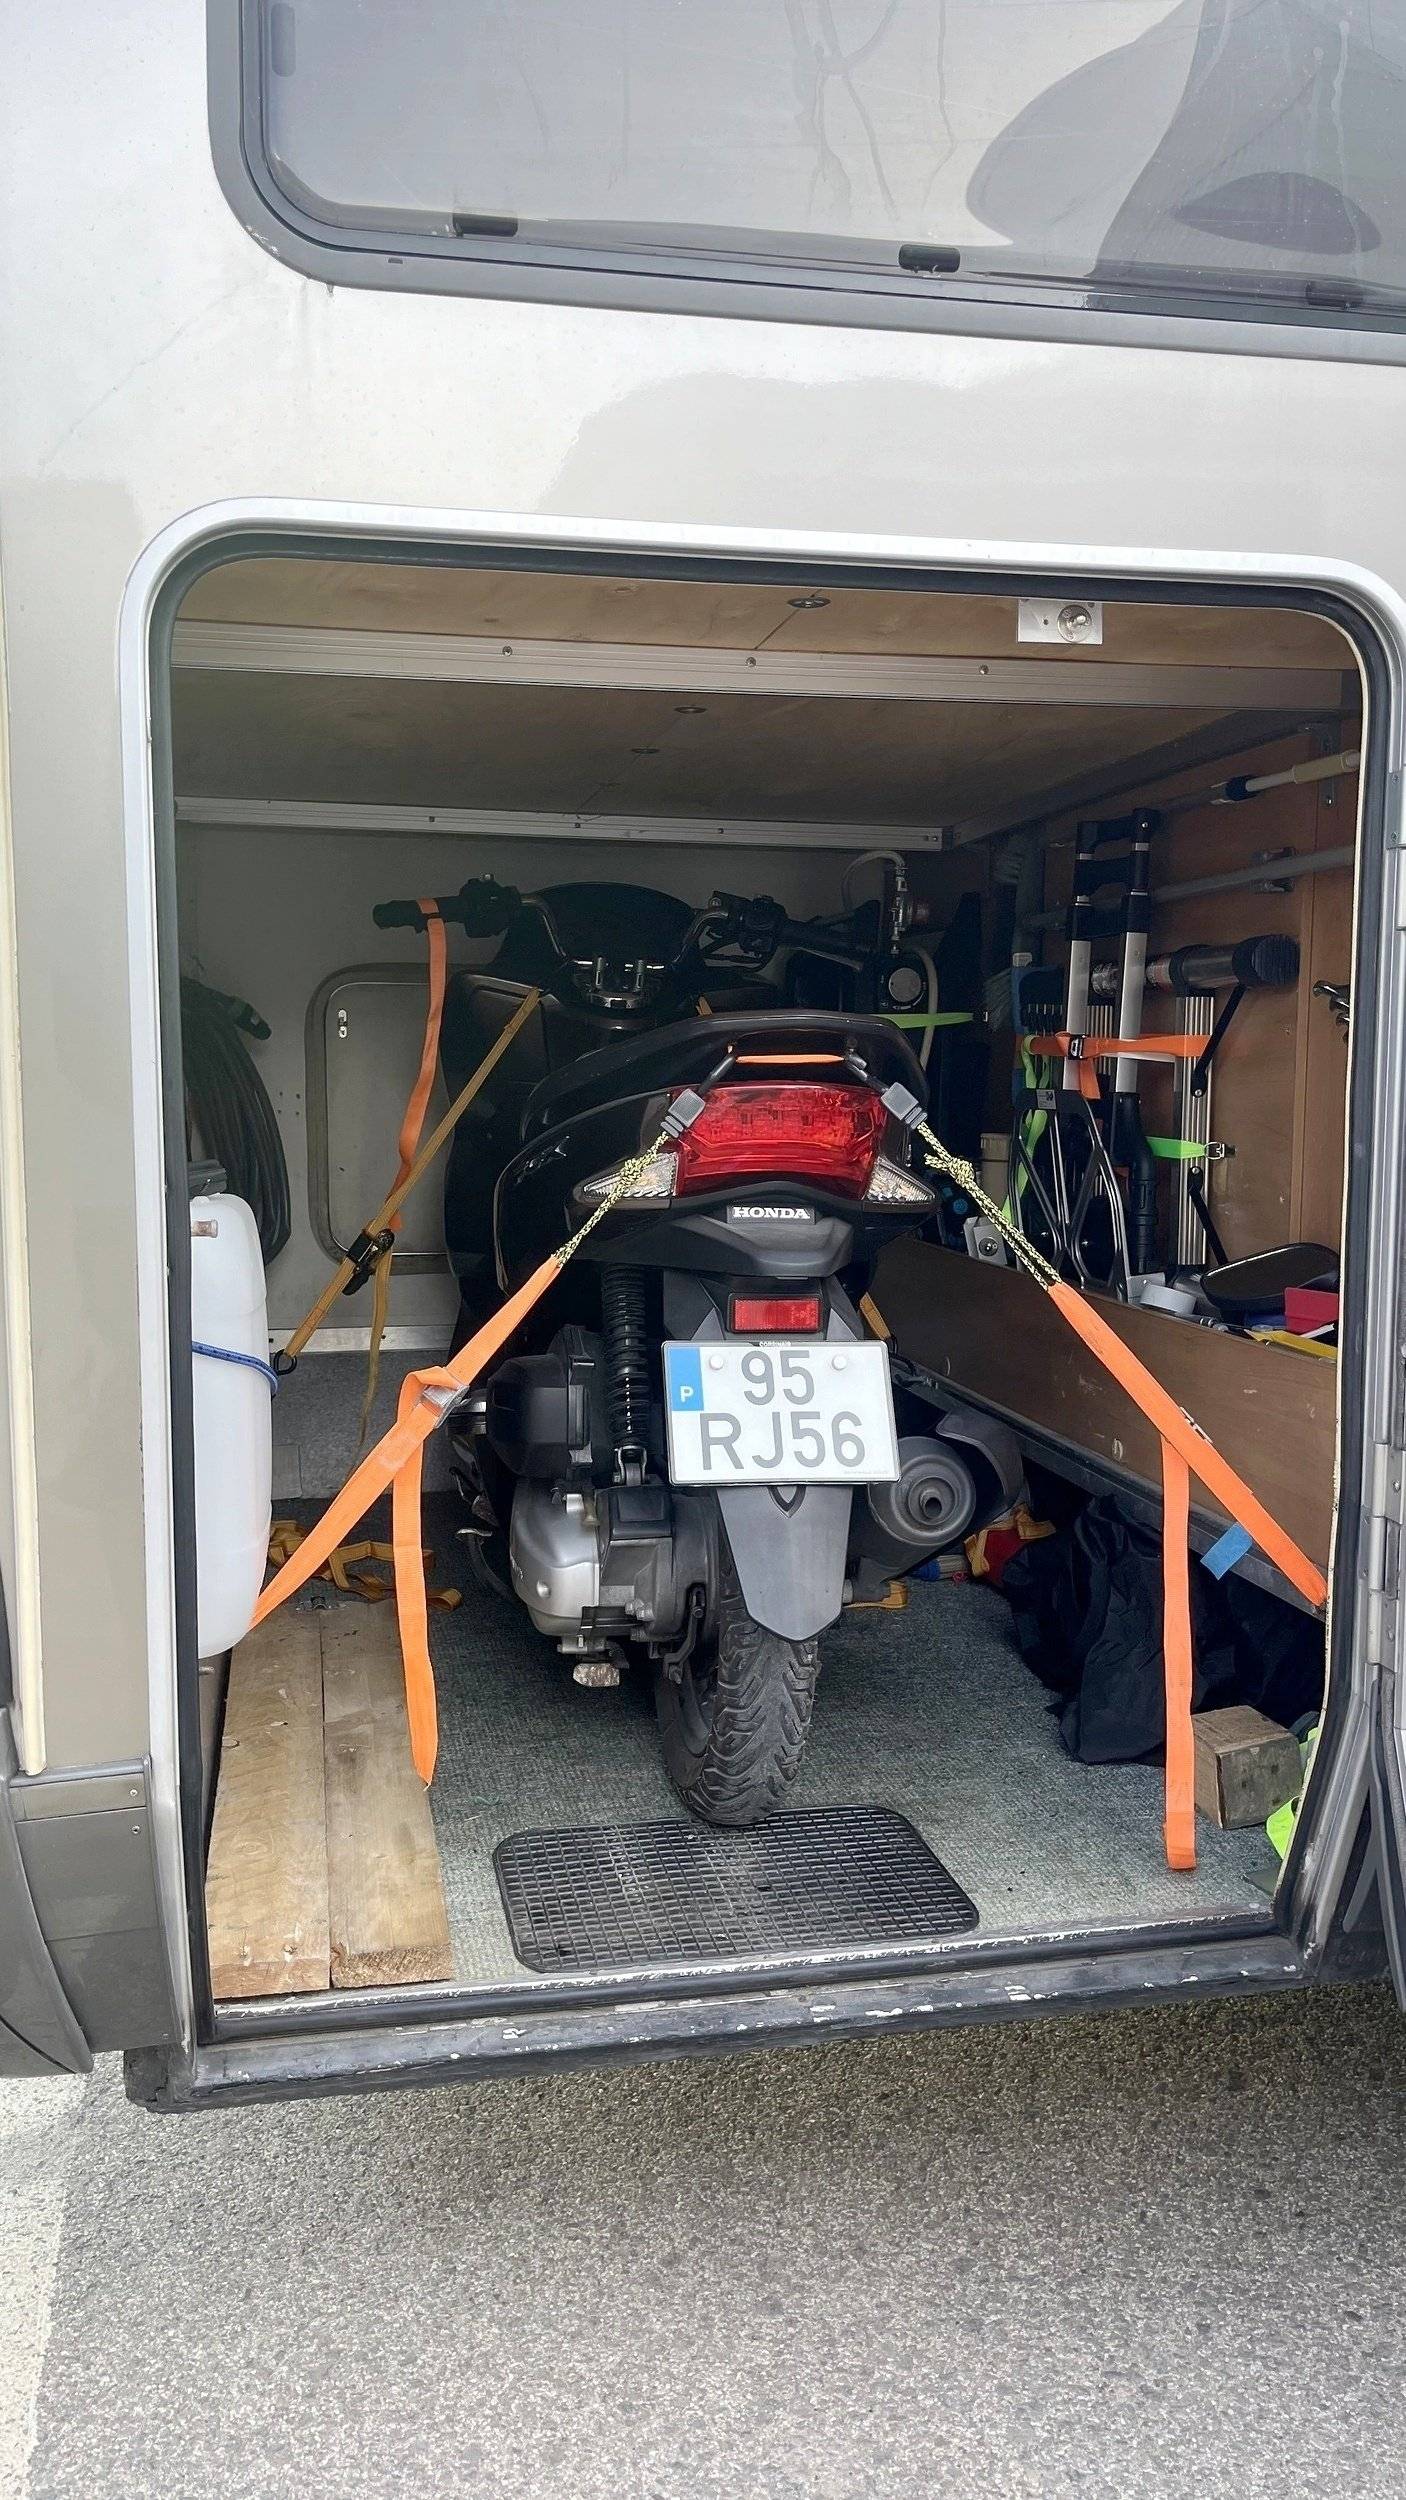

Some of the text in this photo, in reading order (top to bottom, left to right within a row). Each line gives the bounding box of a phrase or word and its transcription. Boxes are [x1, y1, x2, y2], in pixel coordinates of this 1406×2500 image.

[733, 1206, 810, 1219] HONDA
[680, 1386, 694, 1402] P
[741, 1350, 815, 1405] 95
[700, 1411, 865, 1470] RJ56
